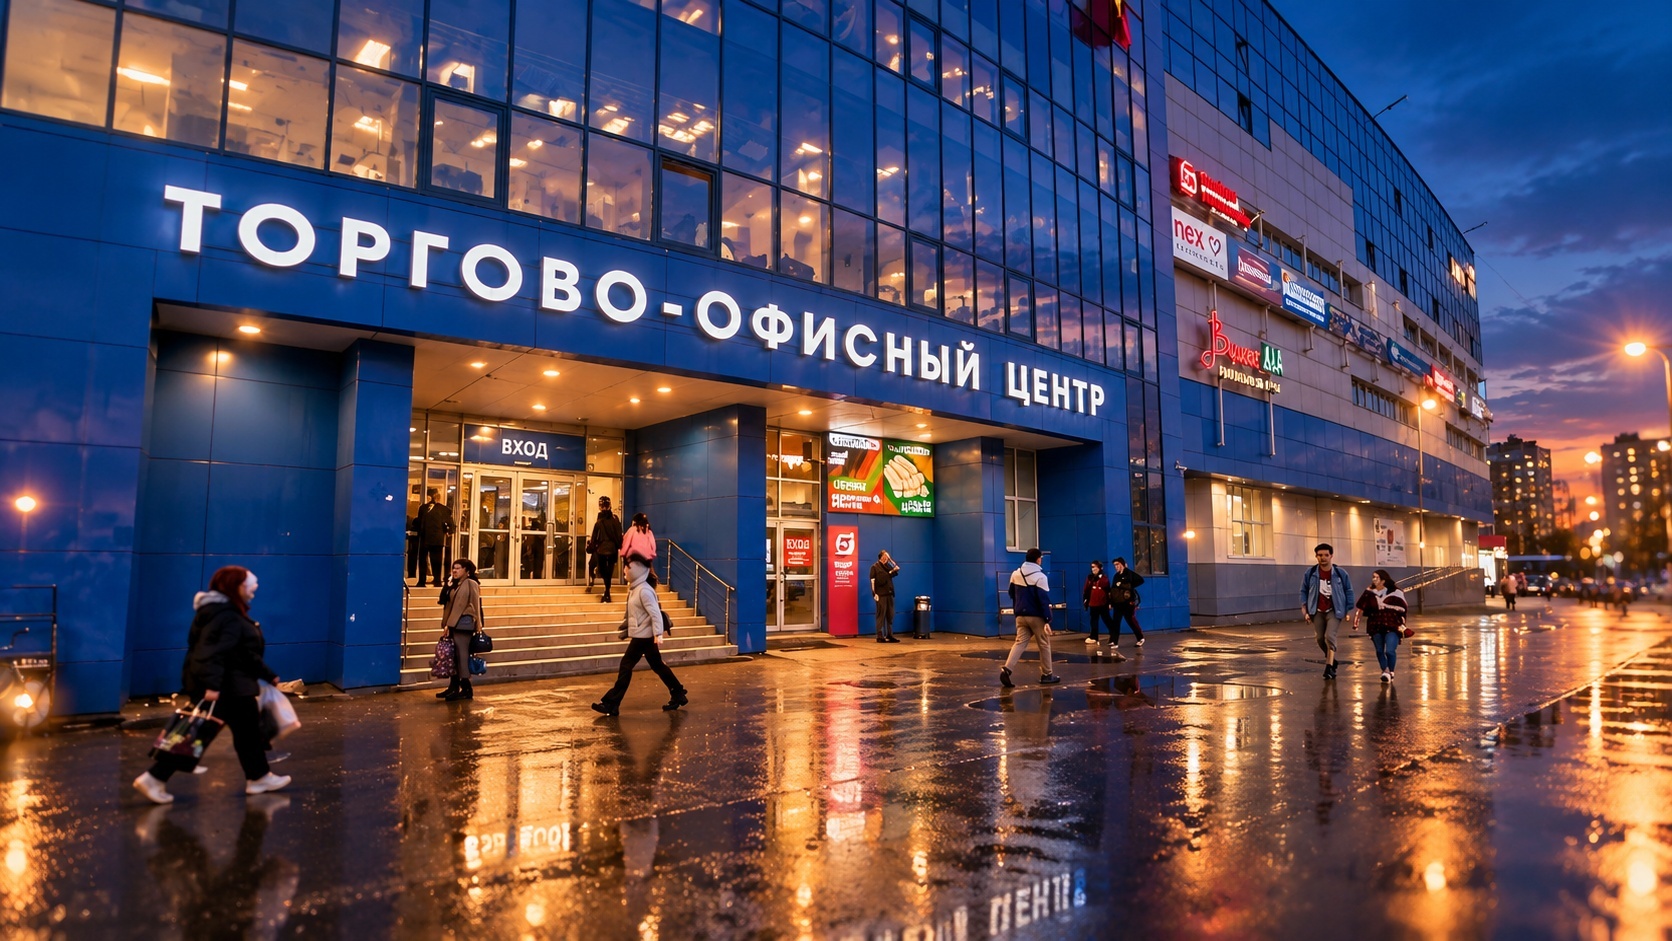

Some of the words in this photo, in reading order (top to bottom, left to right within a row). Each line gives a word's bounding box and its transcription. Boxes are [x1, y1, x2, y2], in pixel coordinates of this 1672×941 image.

[1174, 218, 1205, 251] nex
[164, 184, 980, 391] ТОРГОВО-ОФИСНЫЙ
[1005, 361, 1105, 416] ЦЕНТР
[501, 438, 549, 461] ВХОД
